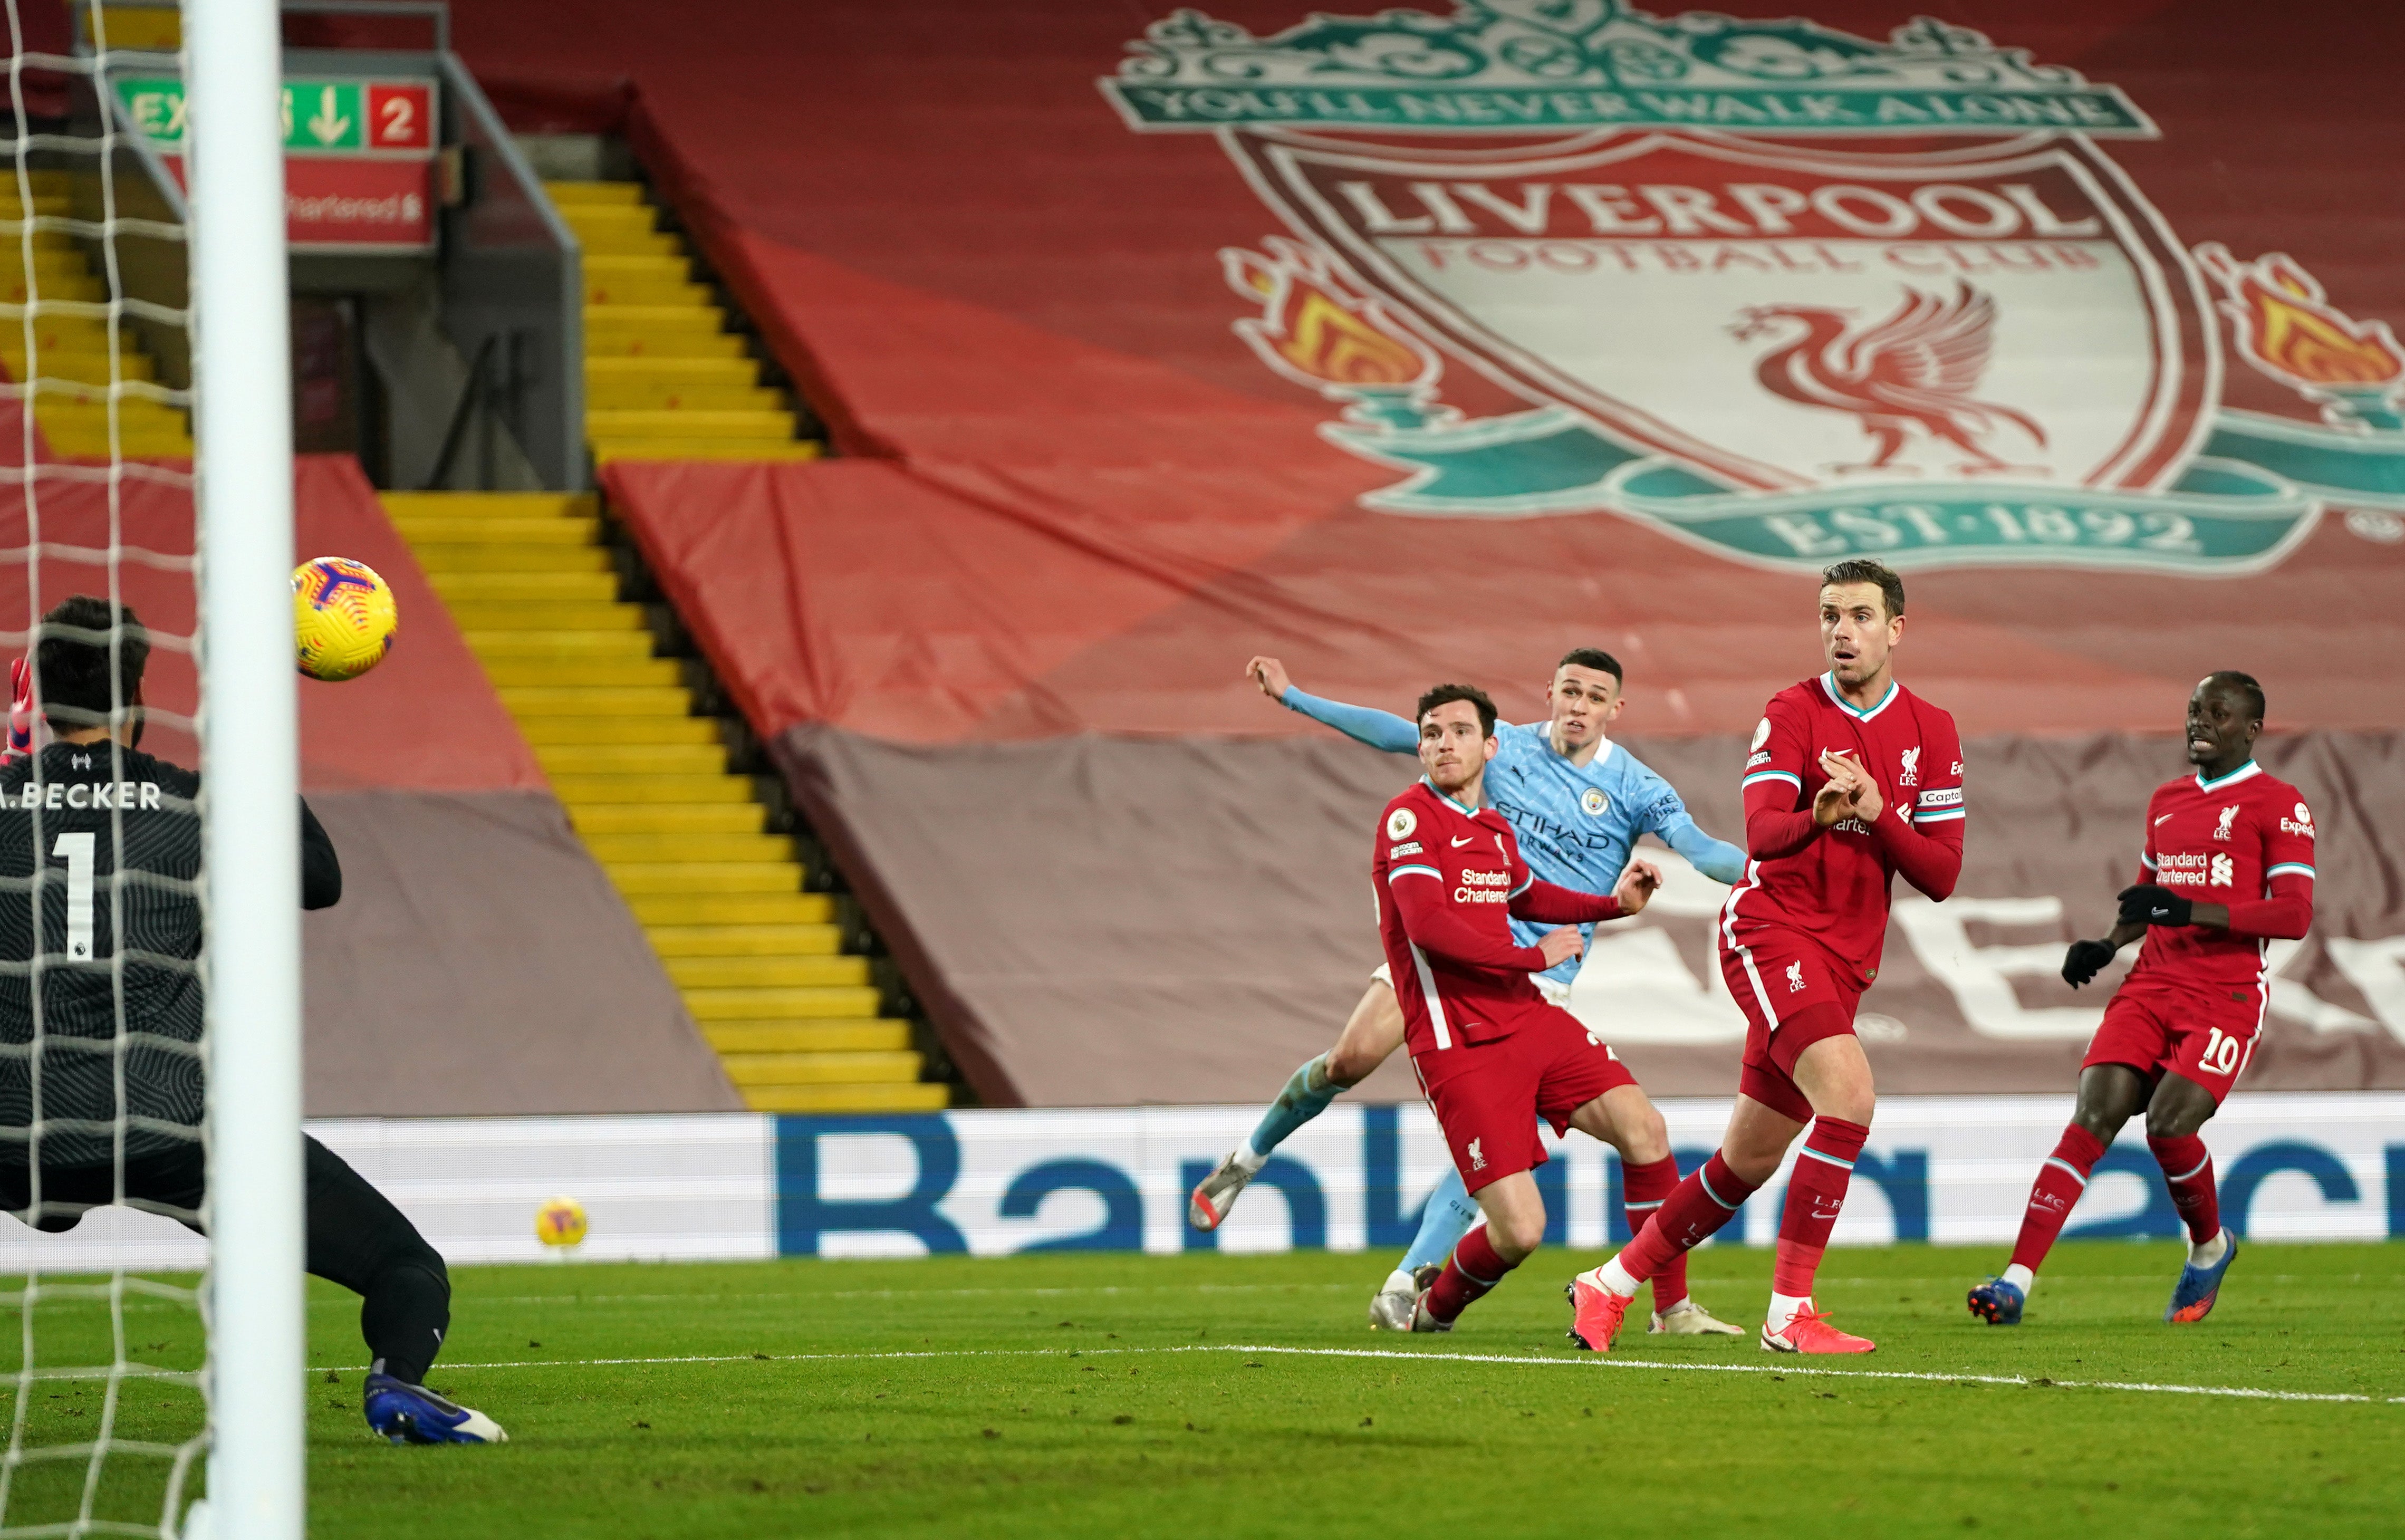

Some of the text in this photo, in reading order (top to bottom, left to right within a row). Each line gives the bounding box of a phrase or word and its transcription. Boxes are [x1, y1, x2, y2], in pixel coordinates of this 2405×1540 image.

[382, 96, 415, 141] 2
[1395, 90, 1638, 122] NEVER
[1638, 92, 1861, 124] WALK
[1878, 94, 2121, 127] ALONE
[1337, 181, 2102, 237] LIVERPOOL
[1418, 239, 2100, 274] FOOTBALL CLUB
[1926, 788, 1963, 803] Captai
[1496, 801, 1610, 850] ETIHAD
[1461, 868, 1508, 886] Standard
[2156, 851, 2207, 868] Standard
[52, 832, 96, 961] 1
[2202, 1026, 2239, 1074] 10
